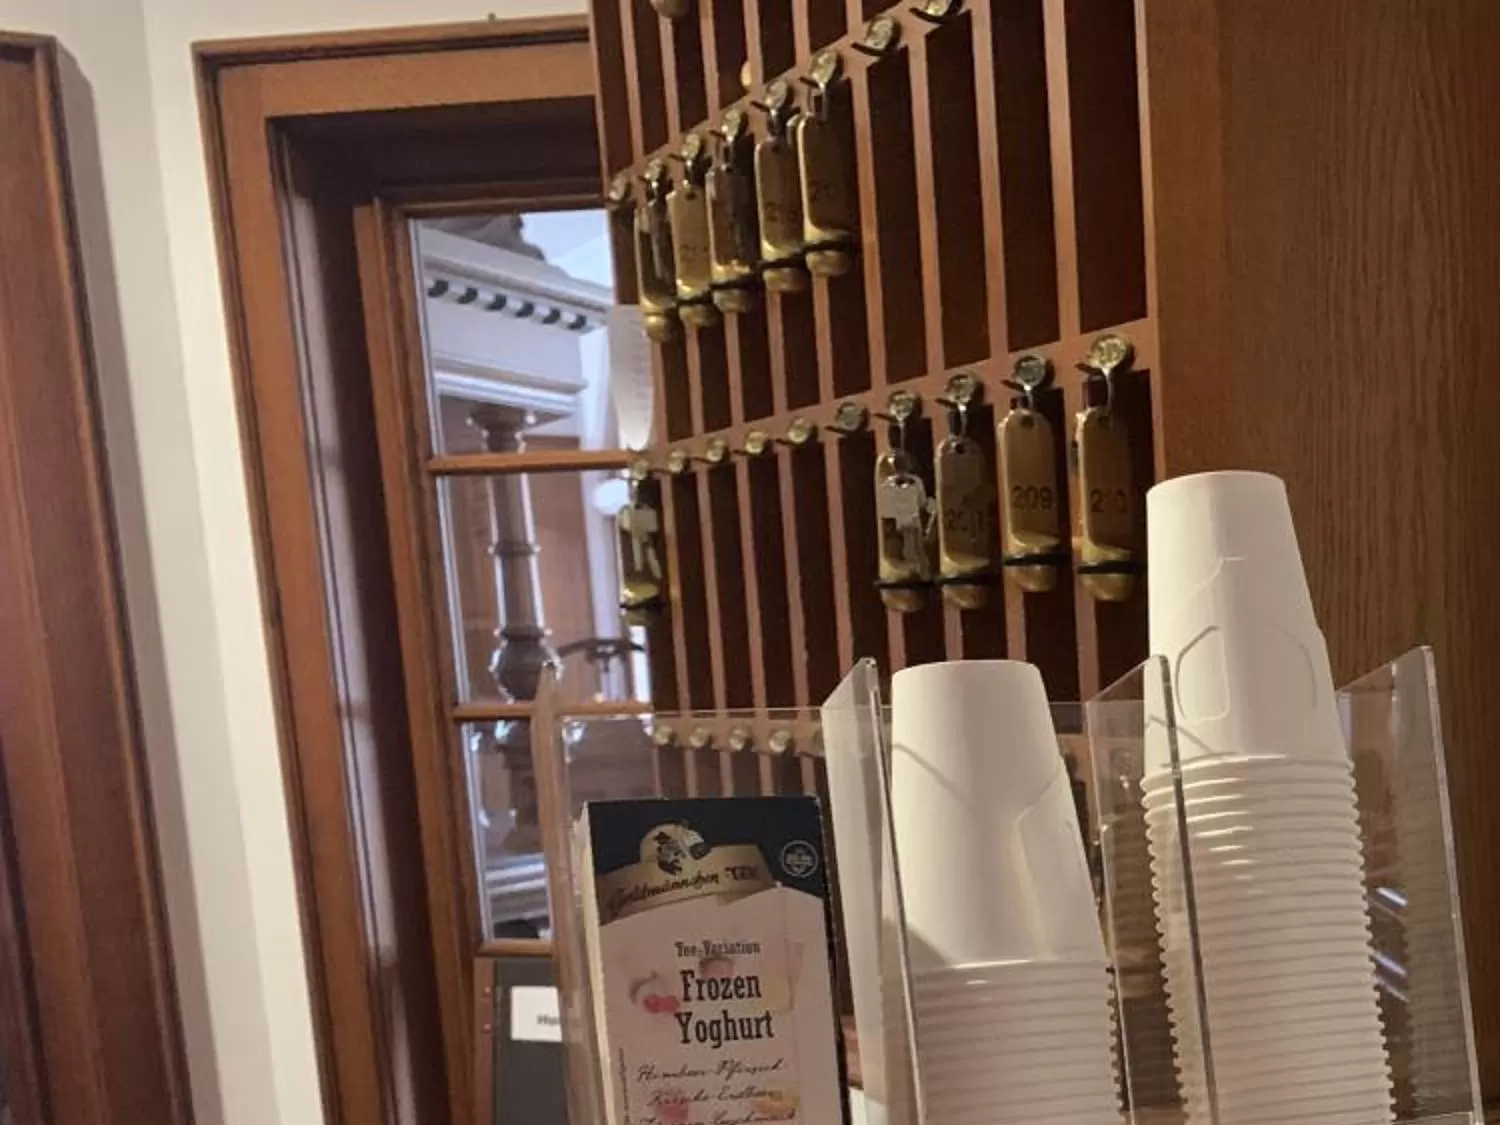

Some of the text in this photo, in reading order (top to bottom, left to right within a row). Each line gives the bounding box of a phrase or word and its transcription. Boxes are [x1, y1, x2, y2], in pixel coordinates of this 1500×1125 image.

[674, 940, 761, 958] Tee-Variation
[680, 969, 763, 1002] Frozen
[674, 1009, 775, 1050] Yoghurt
